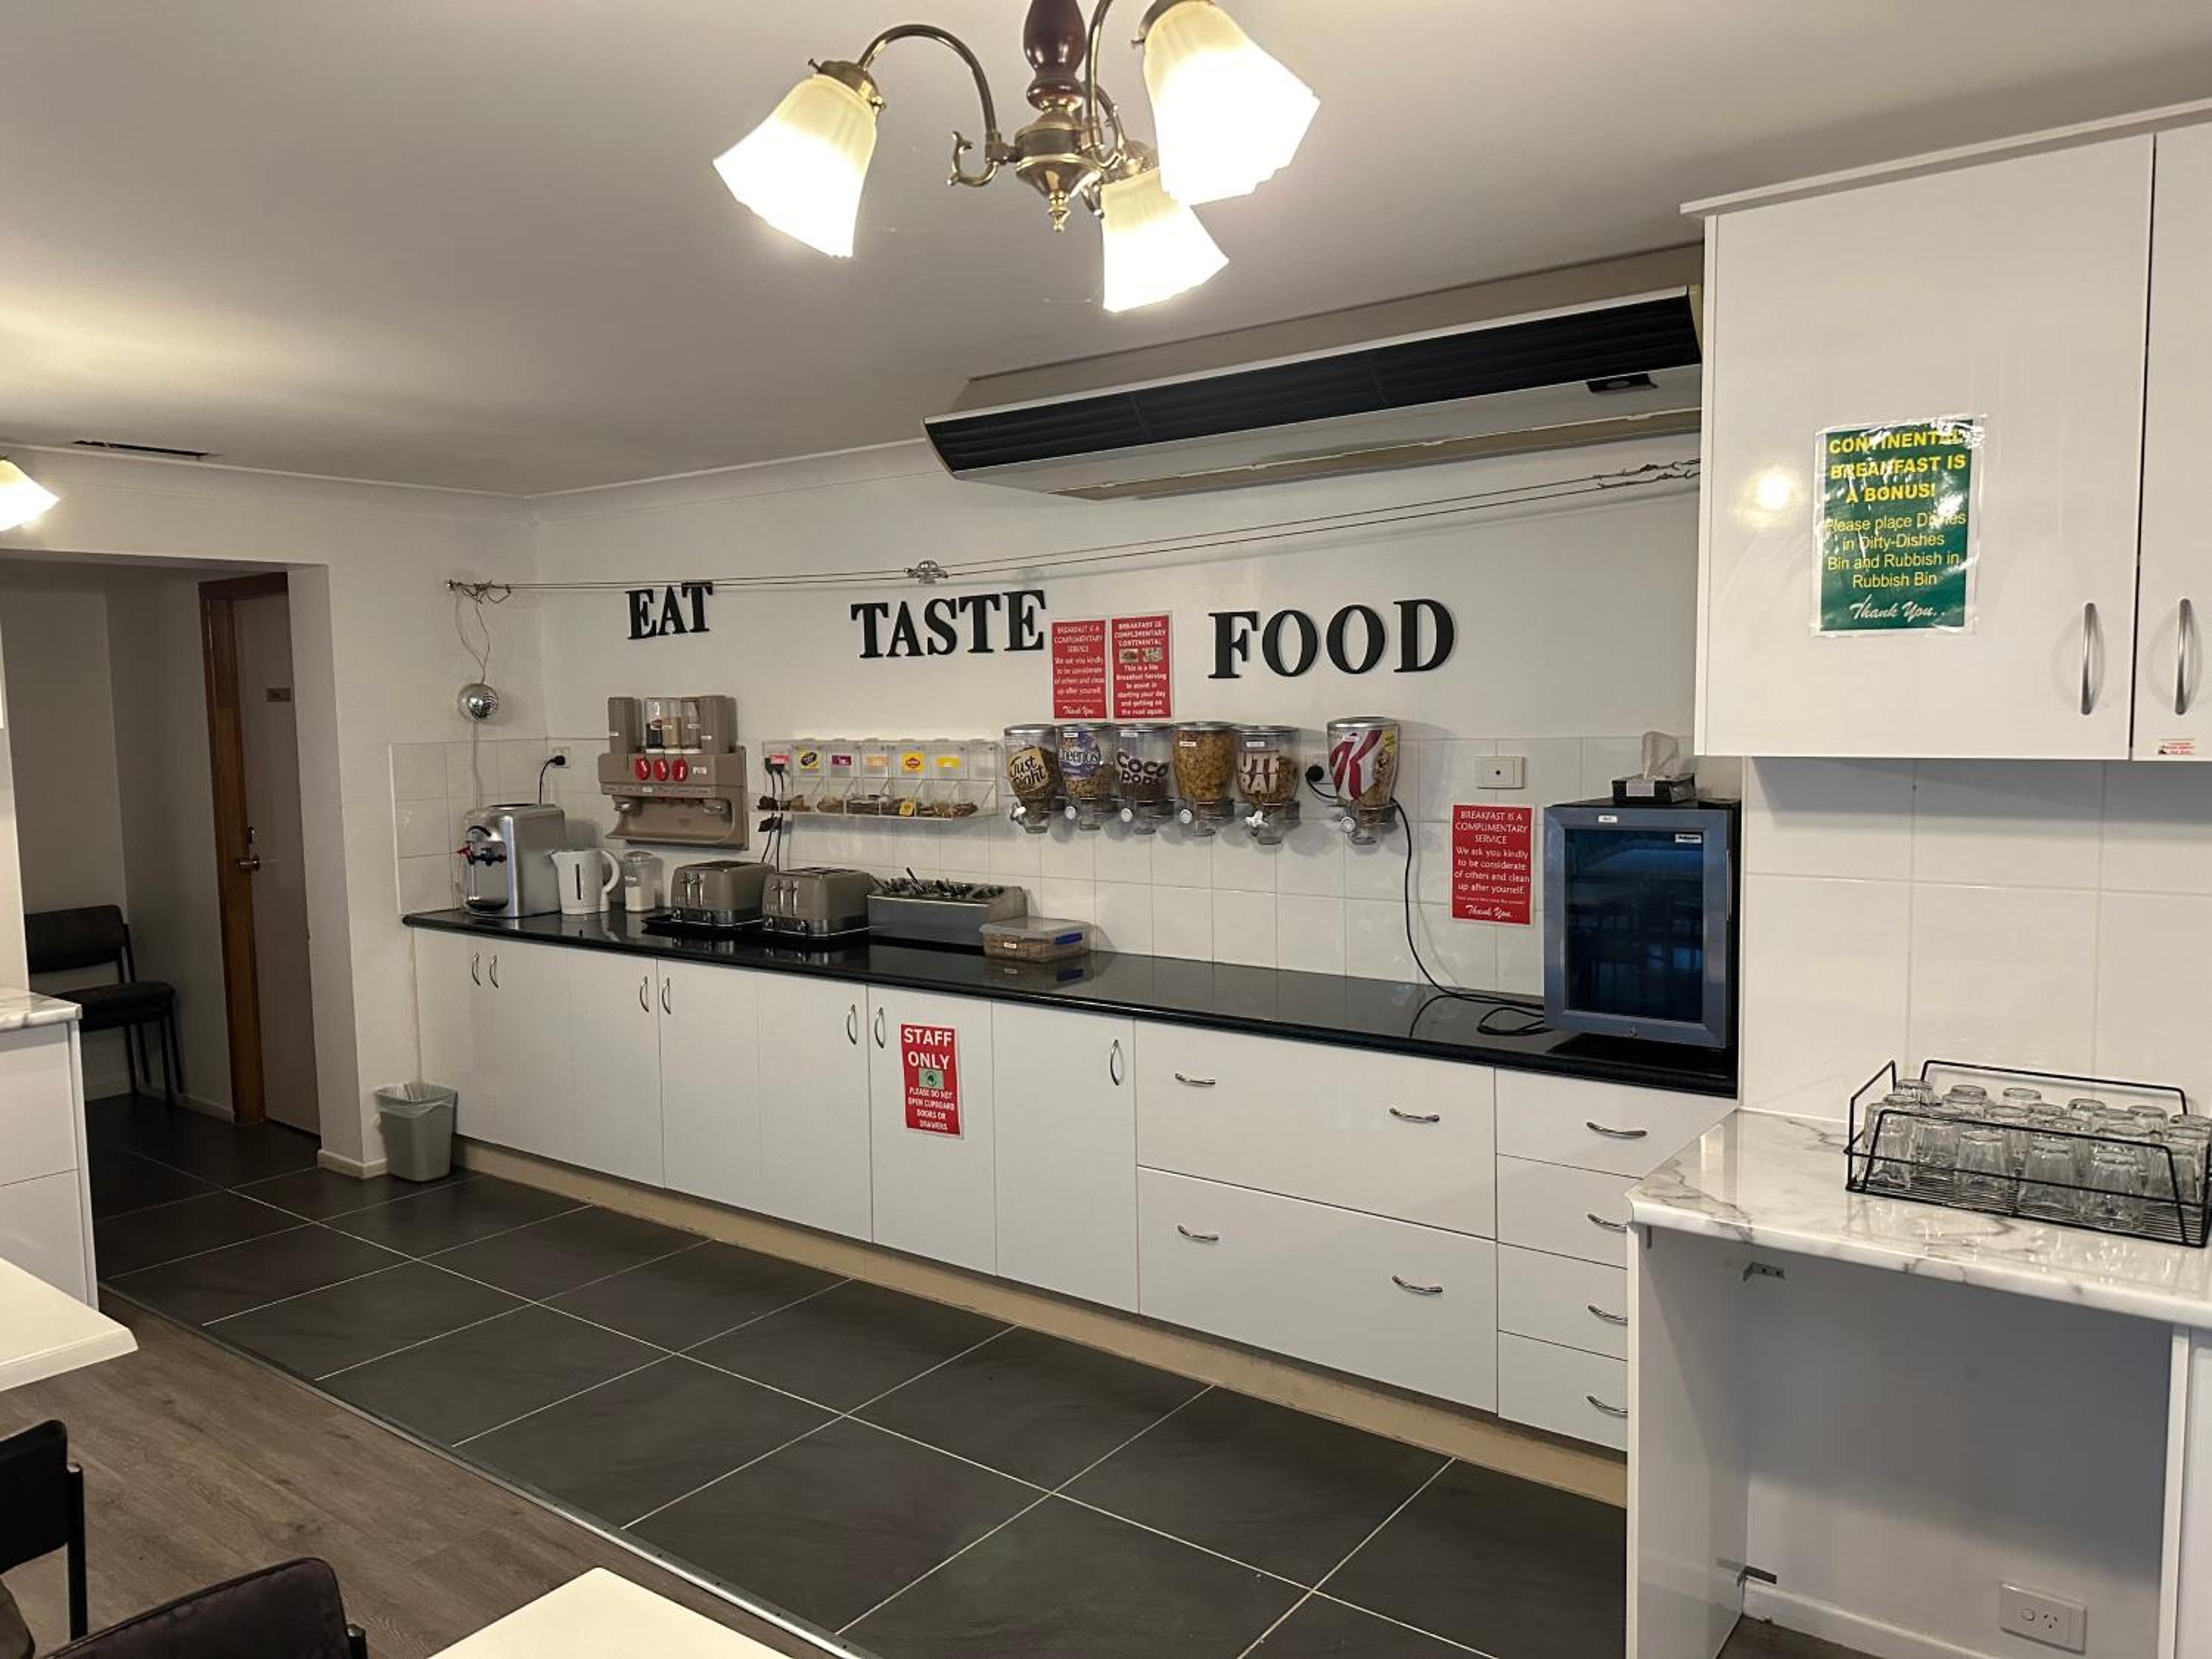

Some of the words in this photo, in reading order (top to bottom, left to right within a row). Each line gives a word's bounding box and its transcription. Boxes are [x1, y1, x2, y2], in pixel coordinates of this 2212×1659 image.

[1828, 428, 1963, 454] CONINENTL
[1830, 456, 1941, 479] BREAKFAST
[1947, 454, 1966, 469] IS
[1846, 487, 1859, 503] A
[1864, 483, 1935, 502] BONUS!
[1826, 518, 1871, 532] Please
[1875, 515, 1912, 533] place
[1843, 539, 1854, 550] in
[1862, 533, 1945, 552] Dirty-Dishes
[1828, 557, 1849, 570] Bin
[1854, 555, 1879, 568] and
[1884, 552, 1941, 567] Rubbish
[1947, 551, 1959, 564] in
[1853, 574, 1909, 588] Rubbish
[1914, 571, 1937, 586] Bin
[625, 581, 714, 640] EAT
[1848, 594, 1898, 619] Thank
[850, 589, 1046, 658] TASTE
[1208, 599, 1455, 679] FOOD
[1009, 755, 1037, 778] Just
[1117, 751, 1169, 777] COCO
[1461, 810, 1506, 820] BREAKFAST
[1475, 834, 1508, 844] SERVICE
[1455, 846, 1469, 855] We
[1471, 847, 1483, 855] ask
[1485, 849, 1501, 858] you
[1503, 849, 1528, 859] kindly
[1468, 859, 1478, 867] be
[1481, 860, 1526, 870] considerate
[1454, 869, 1463, 878] of
[1464, 871, 1489, 880] others
[1491, 873, 1506, 881] and
[1509, 873, 1530, 883] clean
[1471, 883, 1489, 891] after
[1465, 905, 1492, 915] Thank
[903, 1027, 953, 1047] STAFF
[908, 1051, 950, 1070] ONLY
[909, 1086, 930, 1096] PLEASE
[930, 1089, 940, 1098] DO
[940, 1091, 953, 1099] NOT
[917, 1108, 937, 1119] DOORS
